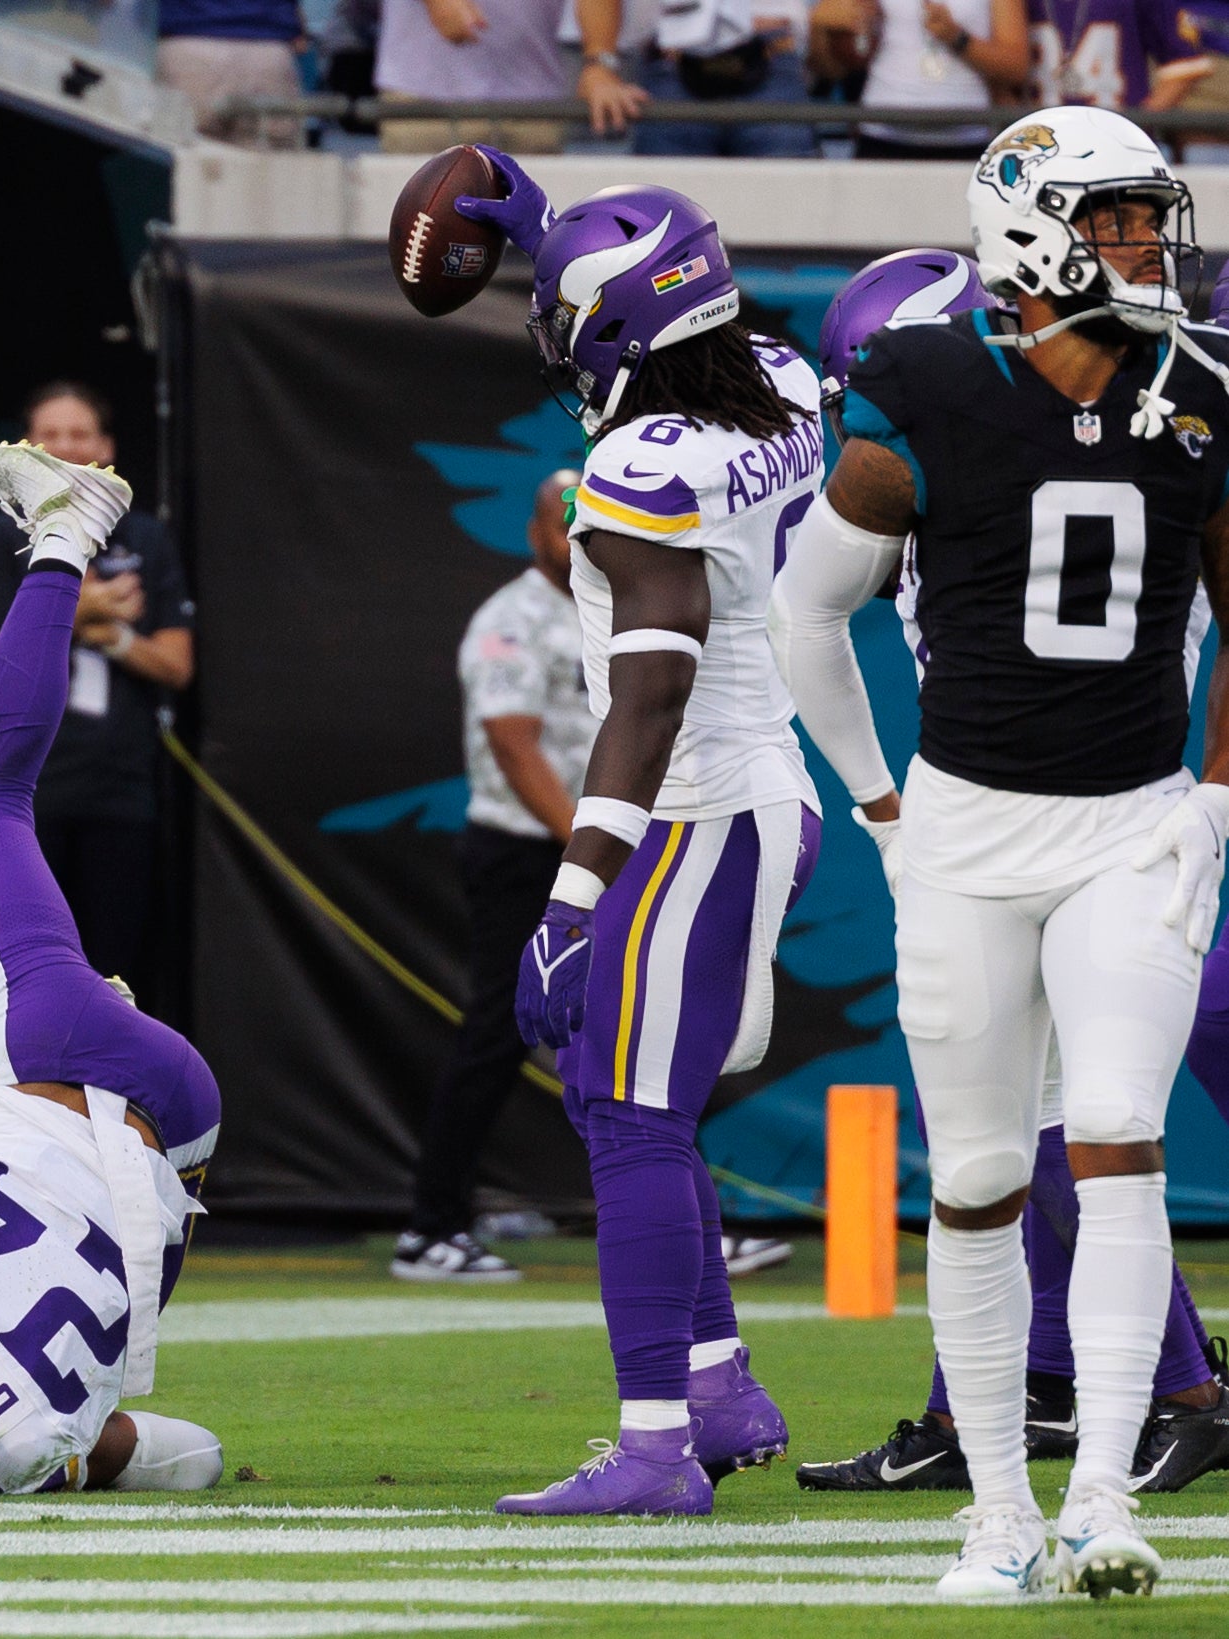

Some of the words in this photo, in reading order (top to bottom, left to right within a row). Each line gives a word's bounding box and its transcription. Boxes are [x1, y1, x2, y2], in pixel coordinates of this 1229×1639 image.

[689, 315, 698, 326] IT
[700, 304, 726, 321] TAKES
[638, 418, 693, 446] 6
[1023, 480, 1147, 662] 0
